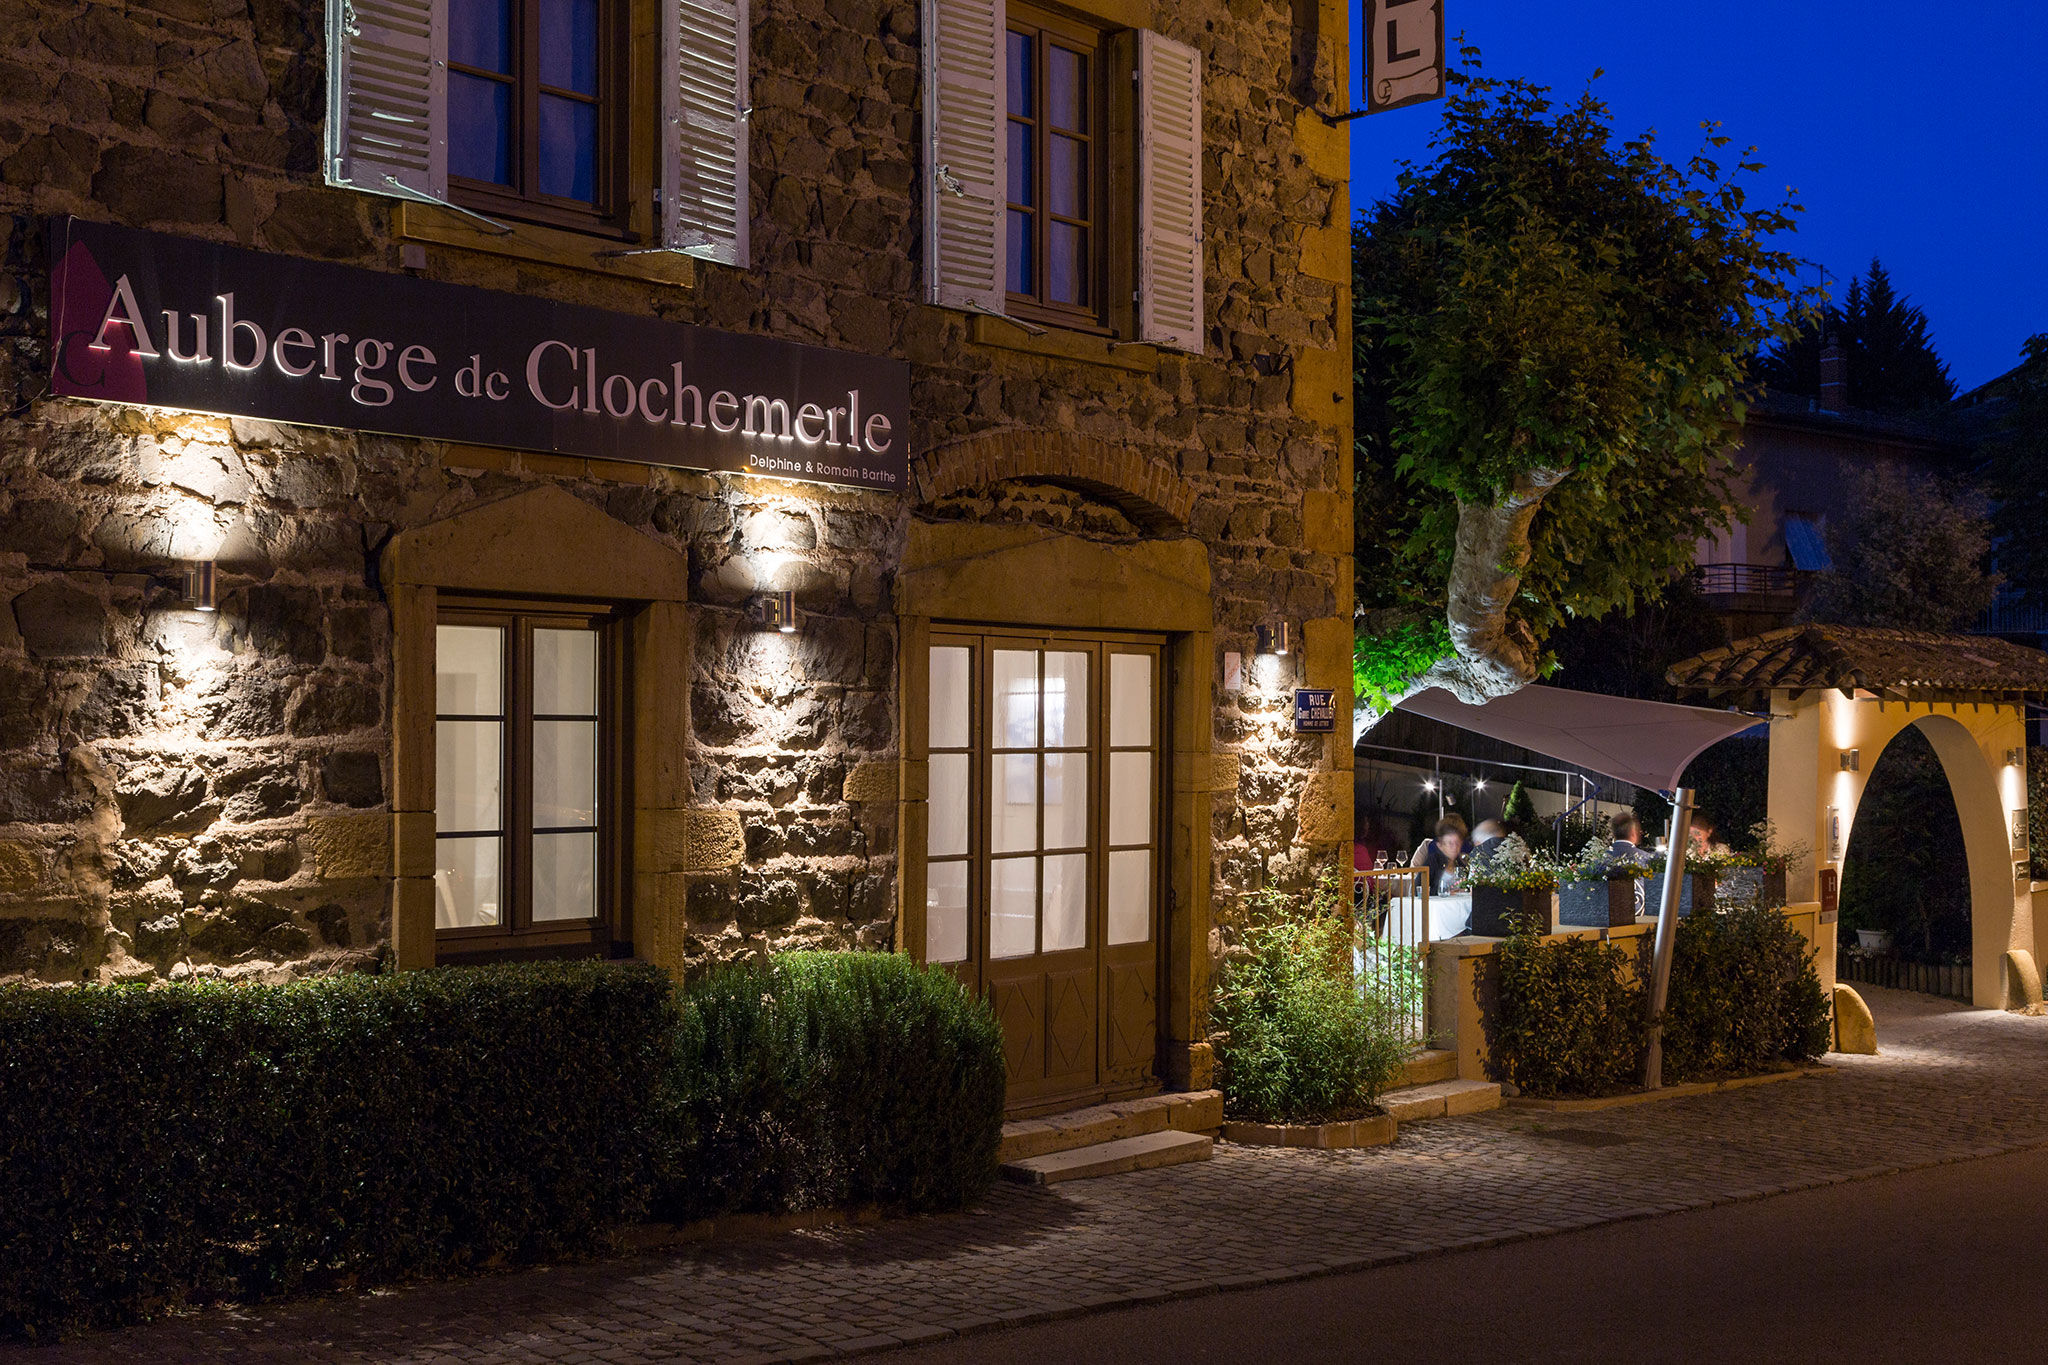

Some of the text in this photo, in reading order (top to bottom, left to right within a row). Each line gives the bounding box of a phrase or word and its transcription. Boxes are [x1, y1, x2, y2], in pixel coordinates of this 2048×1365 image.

[1385, 0, 1420, 64] L
[88, 273, 892, 453] Auberge de Clochemerle
[750, 454, 896, 483] Delphine & Romain Barthe
[1309, 694, 1326, 706] RUE
[1828, 876, 1836, 892] H
